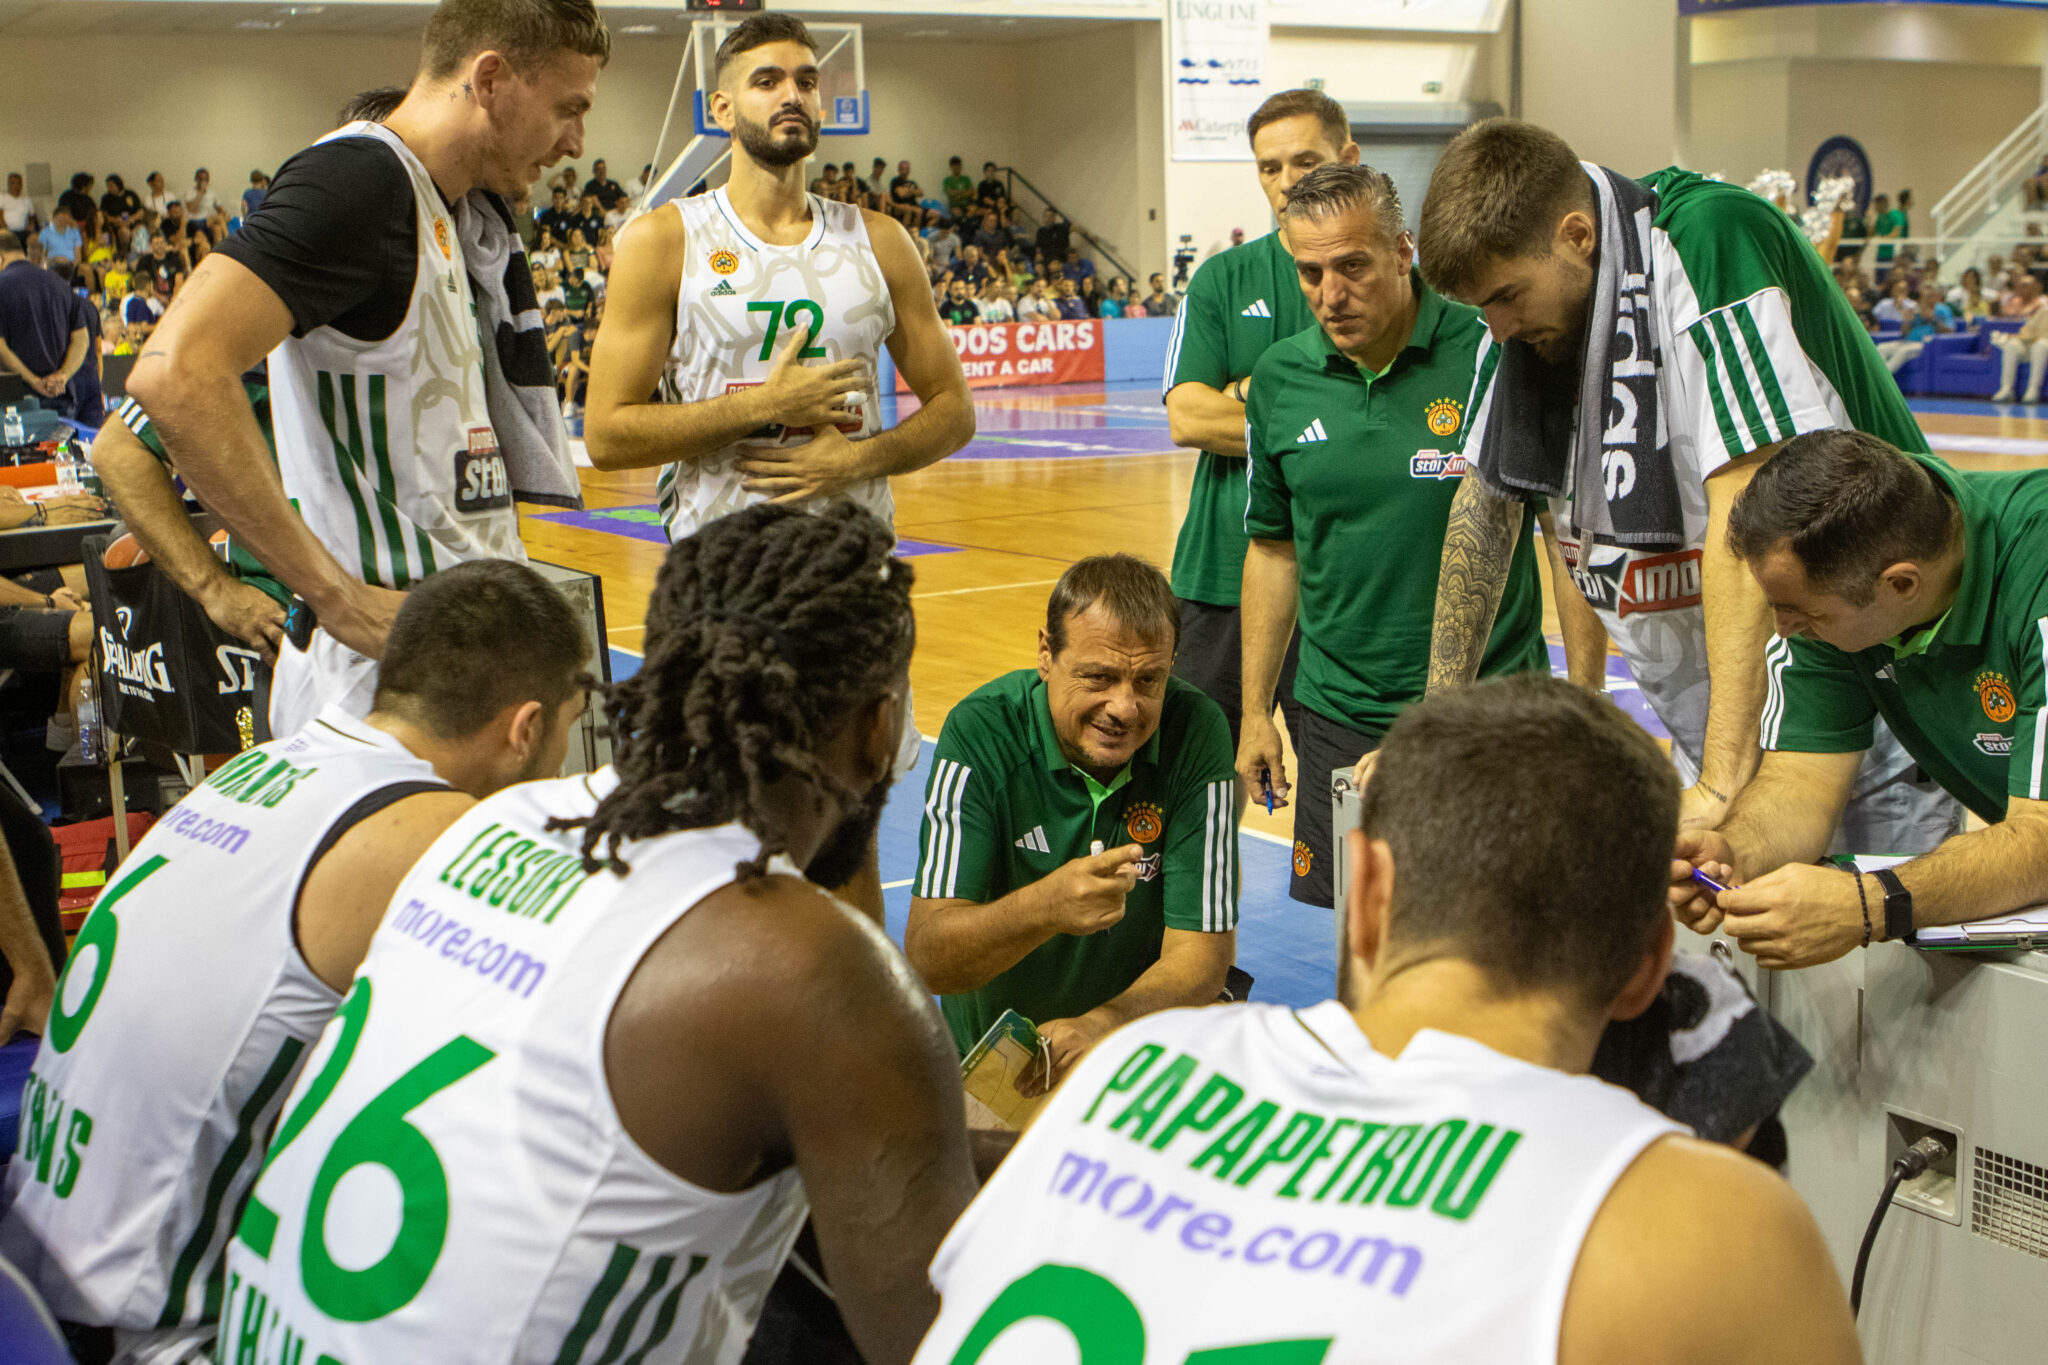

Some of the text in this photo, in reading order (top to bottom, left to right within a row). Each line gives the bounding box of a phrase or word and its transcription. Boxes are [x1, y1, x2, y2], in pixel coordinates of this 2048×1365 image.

[746, 299, 826, 361] 72
[1000, 360, 1014, 375] A
[1017, 358, 1054, 375] CAR
[1016, 321, 1095, 353] CARS
[439, 823, 612, 925] LESSORT
[393, 898, 546, 999] more.com
[237, 976, 498, 1323] 26
[1080, 1041, 1524, 1222] PAPAPETROU
[1047, 1150, 1424, 1298] more.com
